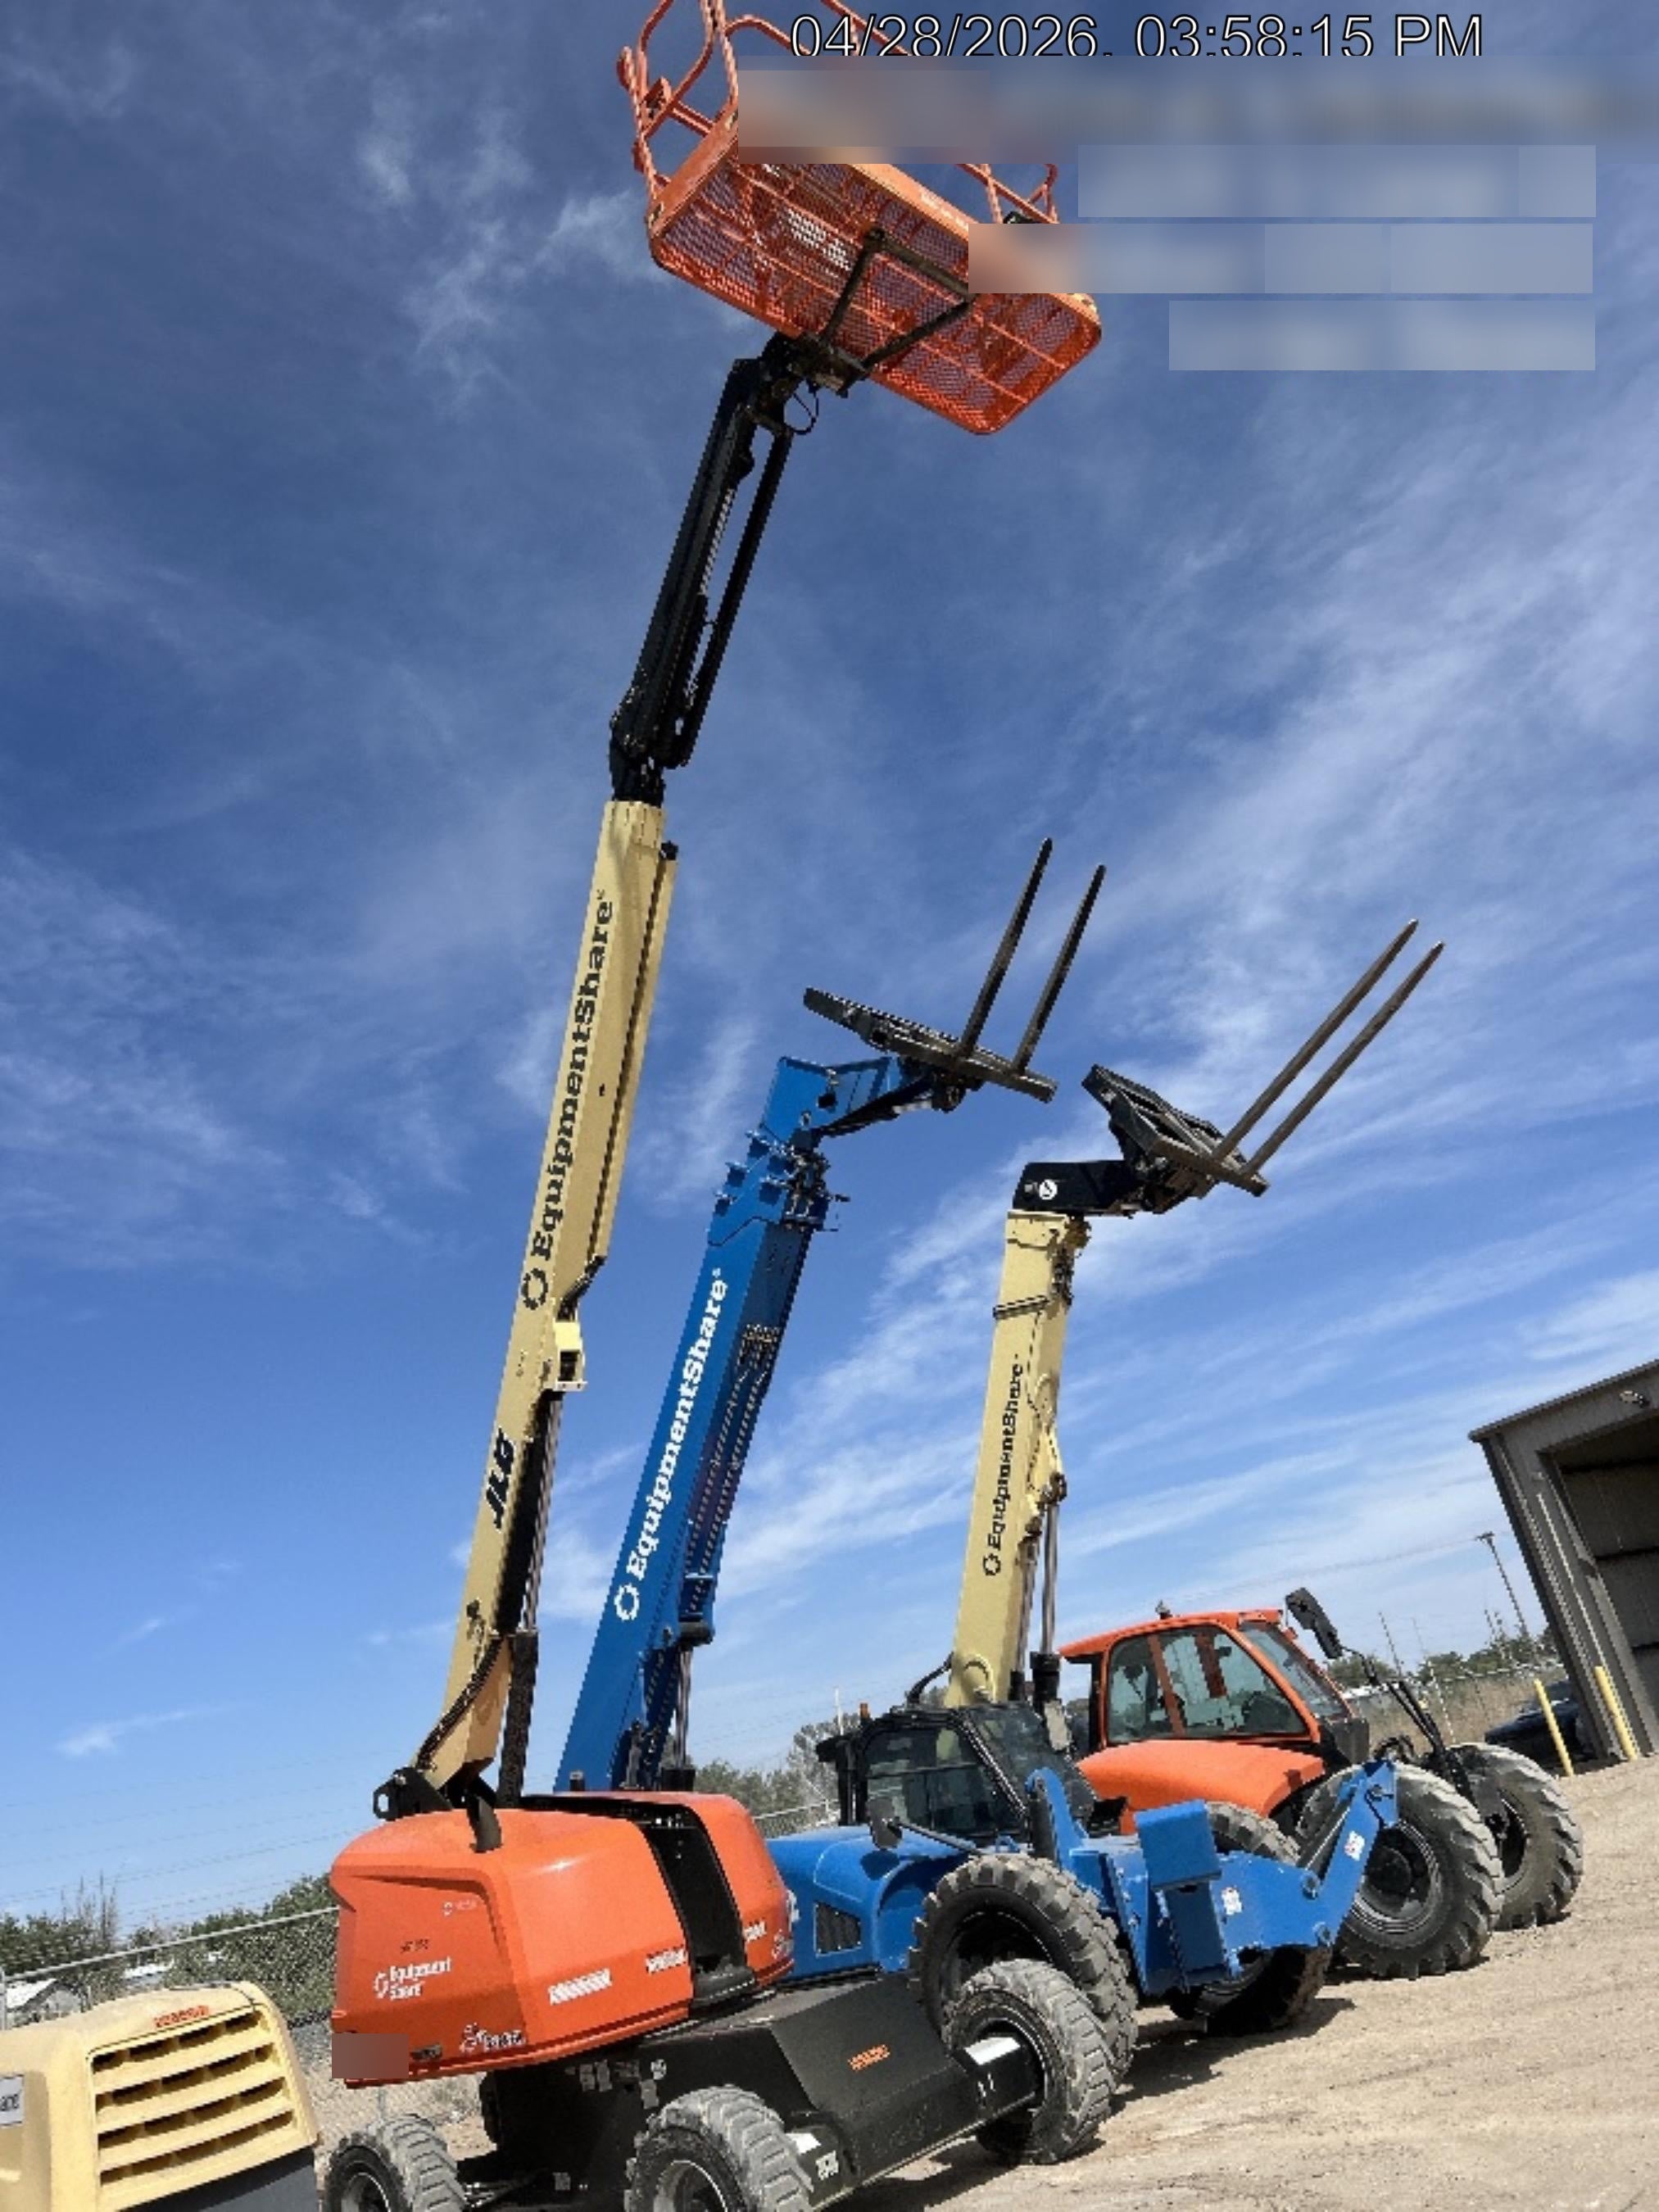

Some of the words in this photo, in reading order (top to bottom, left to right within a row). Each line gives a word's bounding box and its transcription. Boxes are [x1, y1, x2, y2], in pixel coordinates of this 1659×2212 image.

[531, 900, 614, 1262] EquipmentShare
[485, 1426, 514, 1530] JLG
[627, 1279, 728, 1581] EquipmentShare
